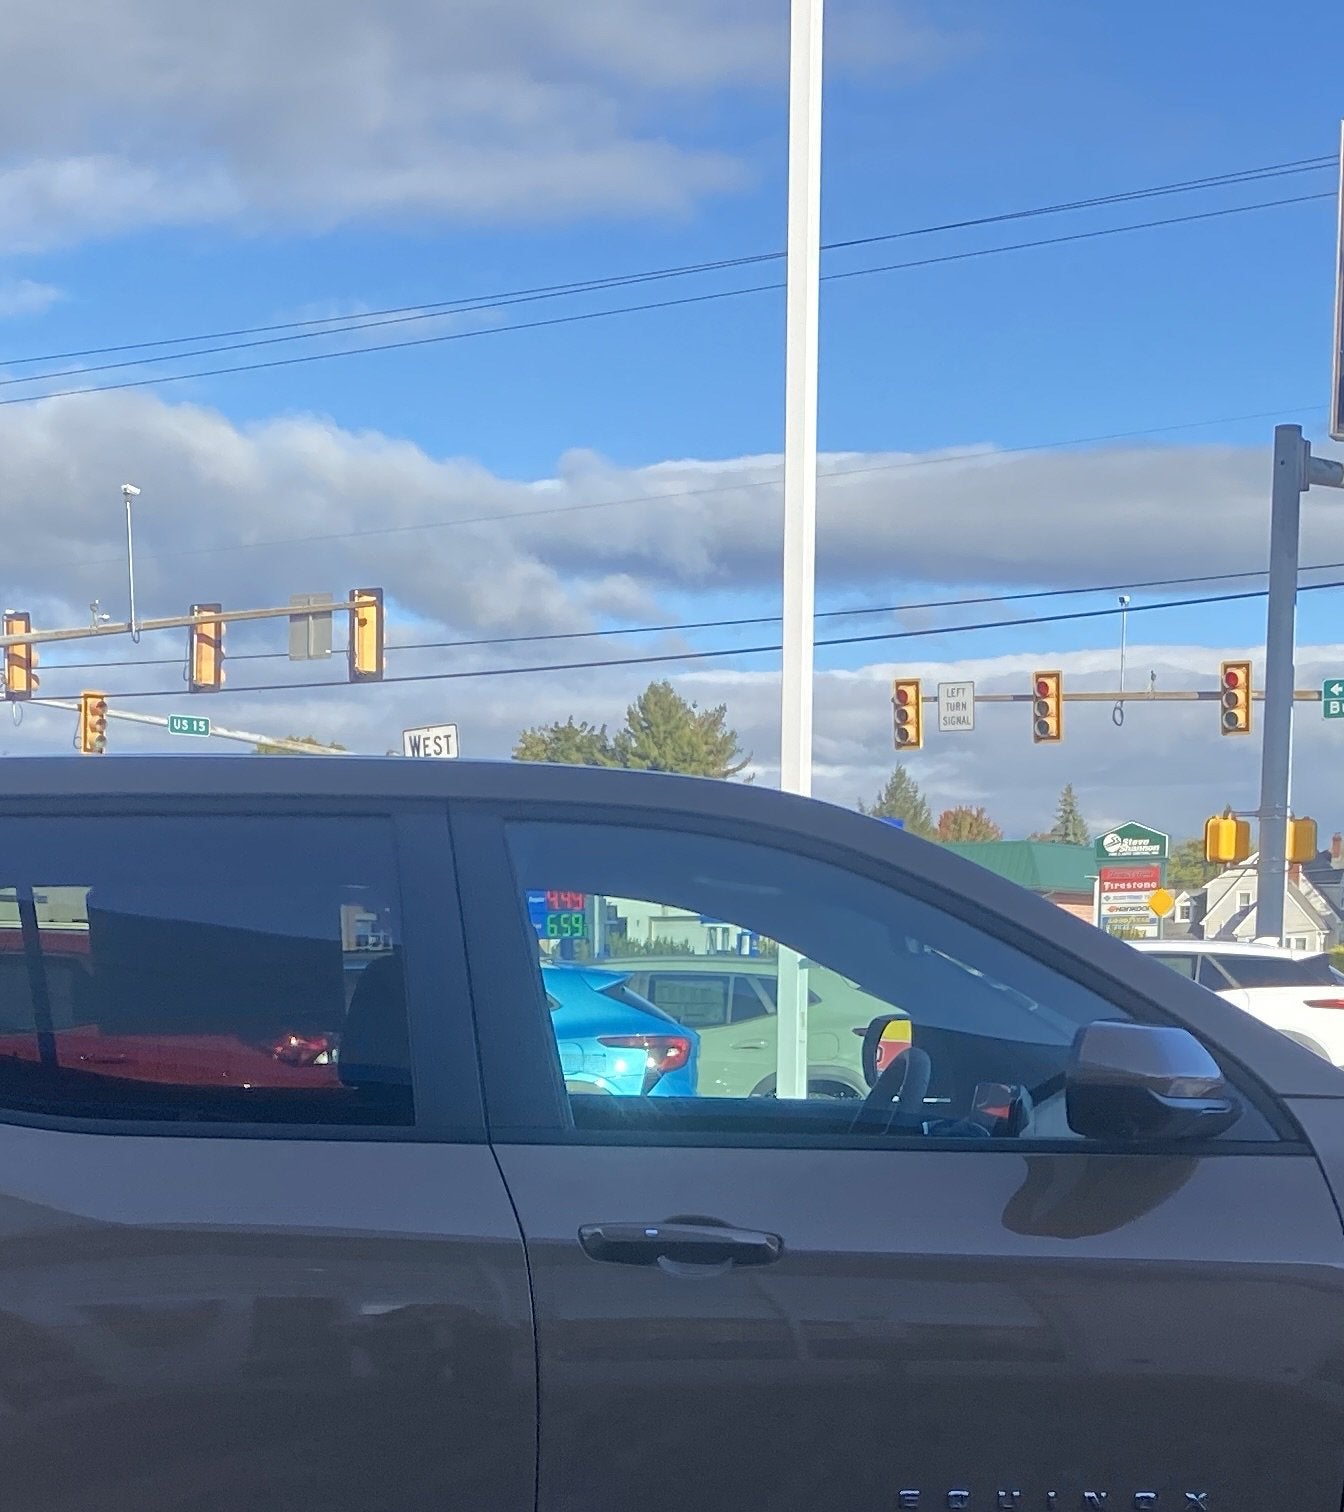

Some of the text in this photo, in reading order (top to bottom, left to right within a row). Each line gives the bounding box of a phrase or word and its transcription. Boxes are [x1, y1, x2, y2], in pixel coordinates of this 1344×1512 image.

[946, 687, 966, 698] LEFT
[945, 702, 967, 712] TURN
[173, 718, 206, 732] US 15
[942, 716, 971, 726] SIGNAL
[408, 735, 452, 758] WEST
[1103, 881, 1157, 891] Firestone
[897, 1489, 1210, 1511] EQUINOX
